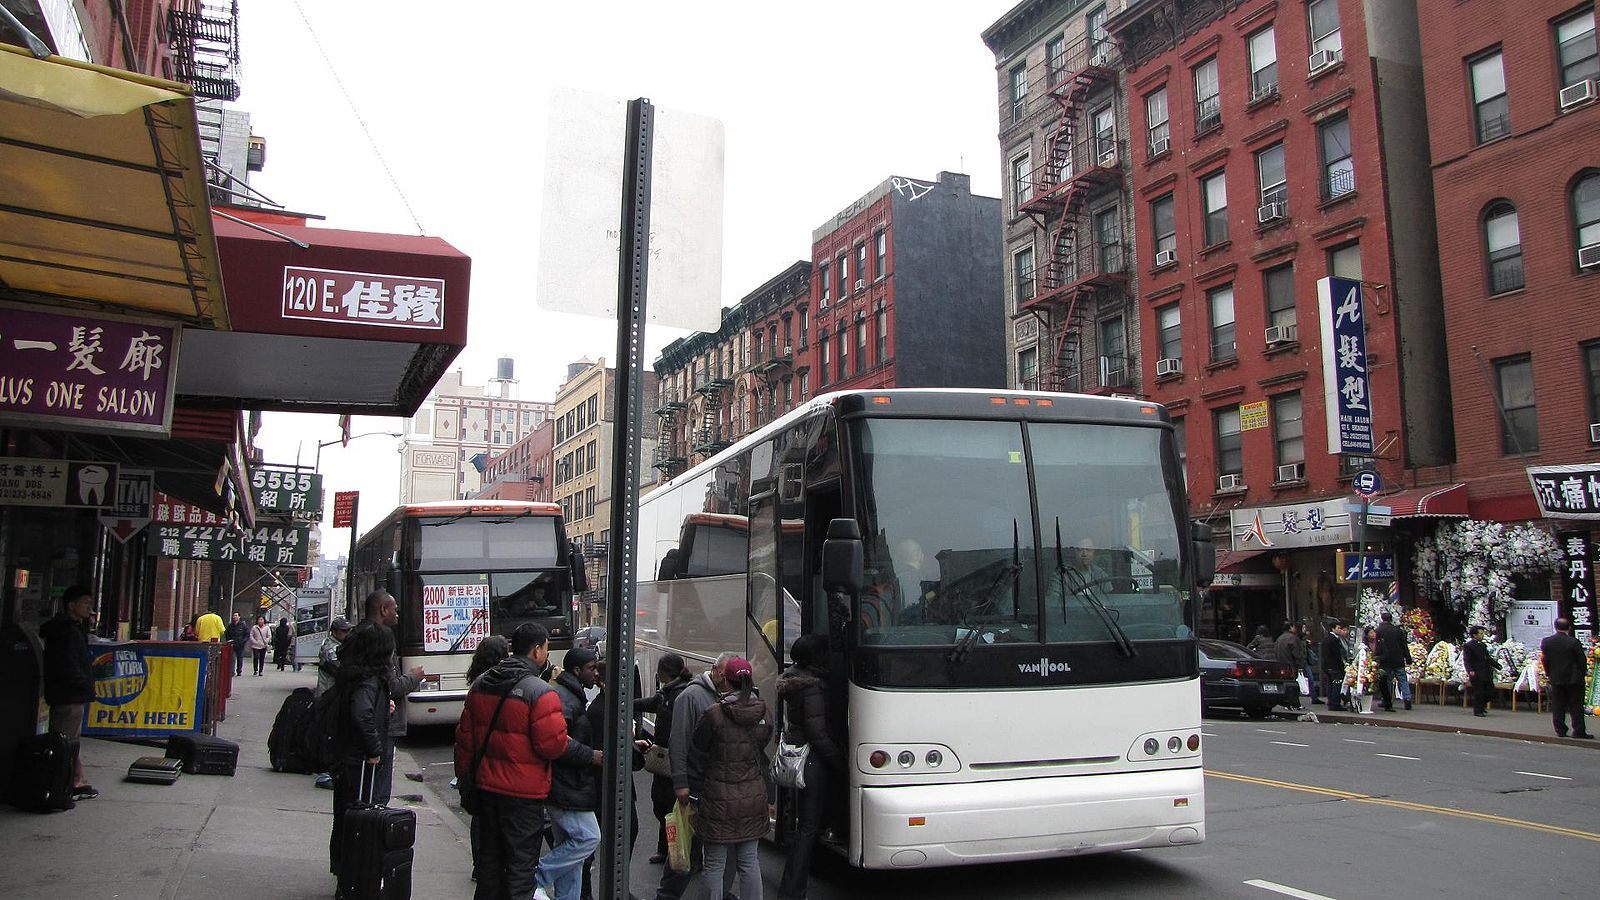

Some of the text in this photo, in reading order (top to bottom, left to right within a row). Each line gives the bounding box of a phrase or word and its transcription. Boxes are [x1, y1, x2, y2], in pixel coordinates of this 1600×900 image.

[286, 276, 317, 311] 120
[322, 279, 339, 313] E.
[46, 380, 86, 410] ONE
[96, 386, 157, 417] SALON
[253, 471, 311, 492] 5555
[118, 480, 149, 505] TM
[119, 505, 142, 513] ERE
[160, 527, 180, 537] 212
[1242, 510, 1274, 547] A
[162, 538, 294, 564] 職業介紹所
[424, 586, 445, 606] 2000
[115, 650, 138, 661] NEW
[118, 661, 144, 676] YORK
[96, 709, 188, 726] PLAY HERE
